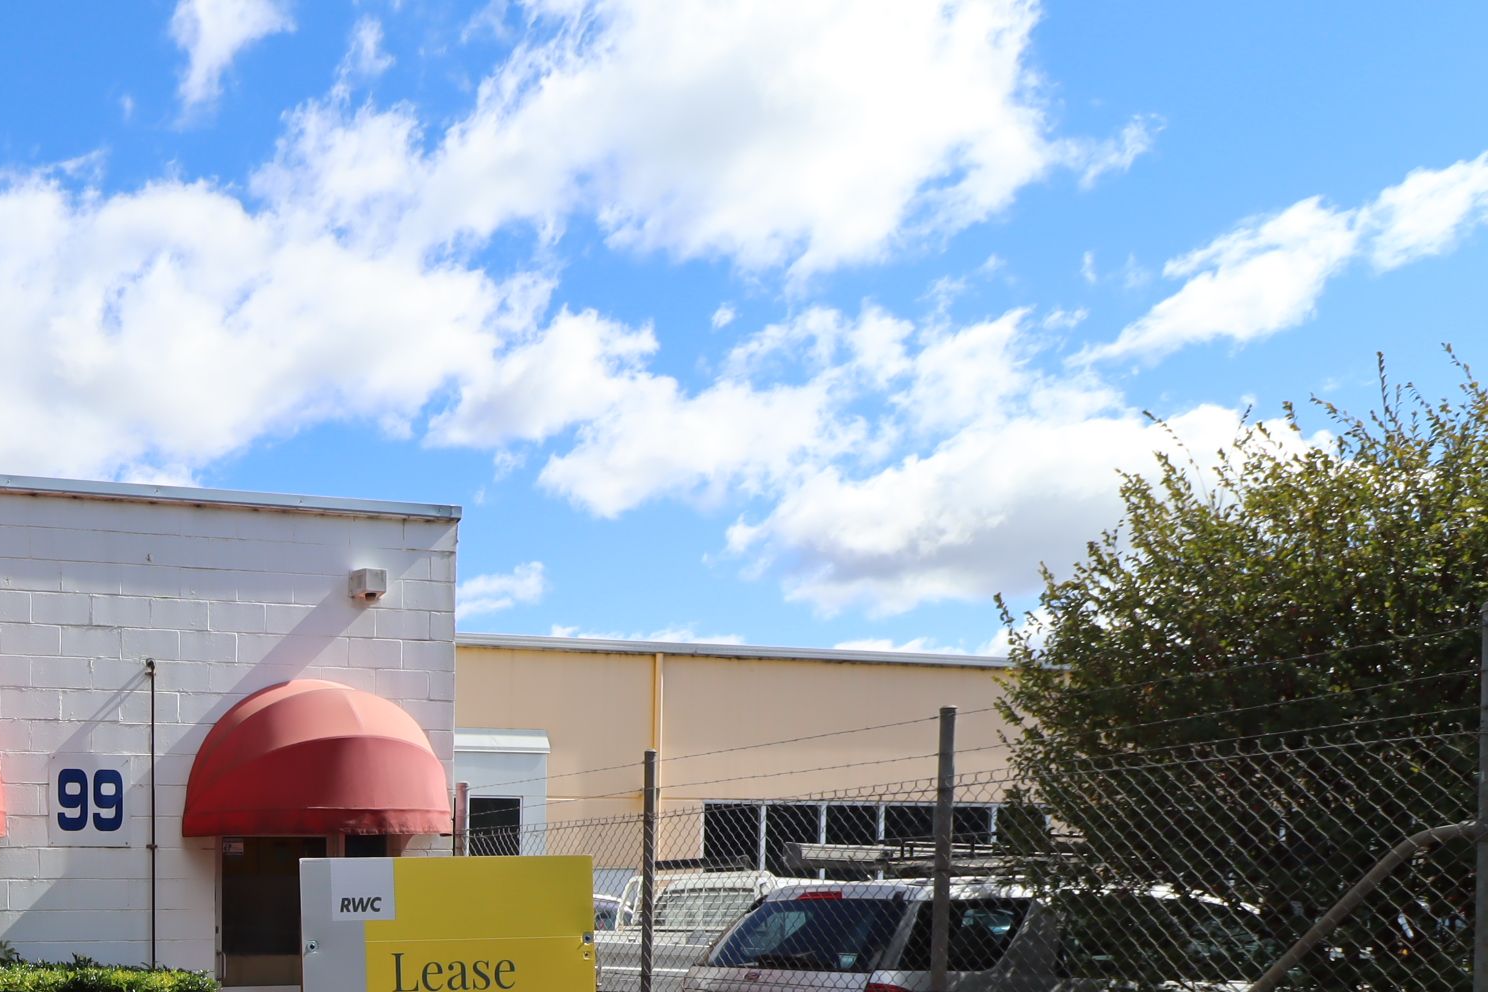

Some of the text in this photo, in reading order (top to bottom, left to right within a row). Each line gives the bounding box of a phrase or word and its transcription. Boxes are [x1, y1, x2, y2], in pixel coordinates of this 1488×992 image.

[57, 768, 123, 832] 99
[340, 897, 382, 913] RWC
[391, 952, 516, 992] Lease
